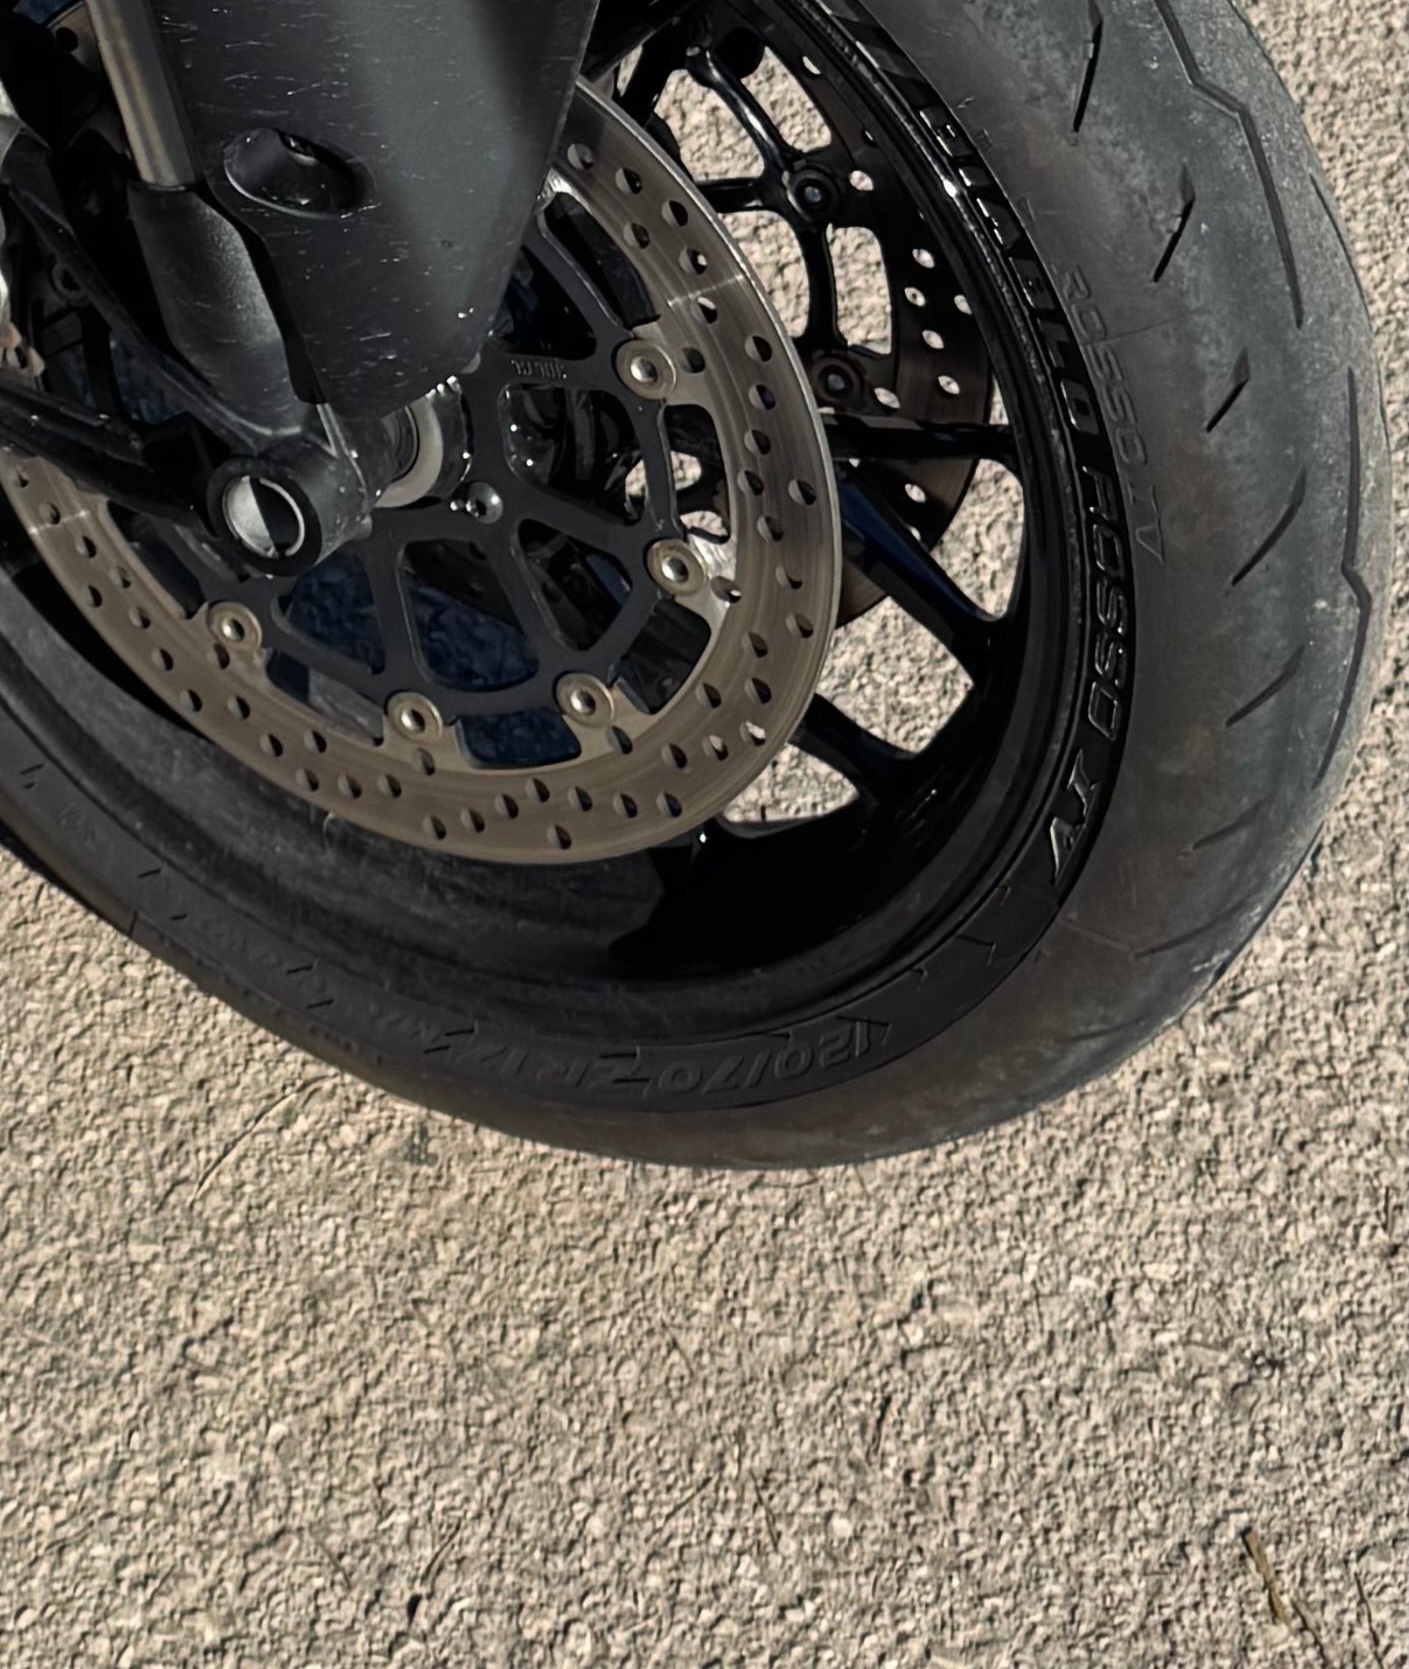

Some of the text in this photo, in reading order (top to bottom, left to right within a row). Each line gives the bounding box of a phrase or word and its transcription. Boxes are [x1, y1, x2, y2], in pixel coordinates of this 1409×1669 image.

[918, 105, 1100, 436] DIABLO
[1048, 464, 1128, 886] ROSSO IV
